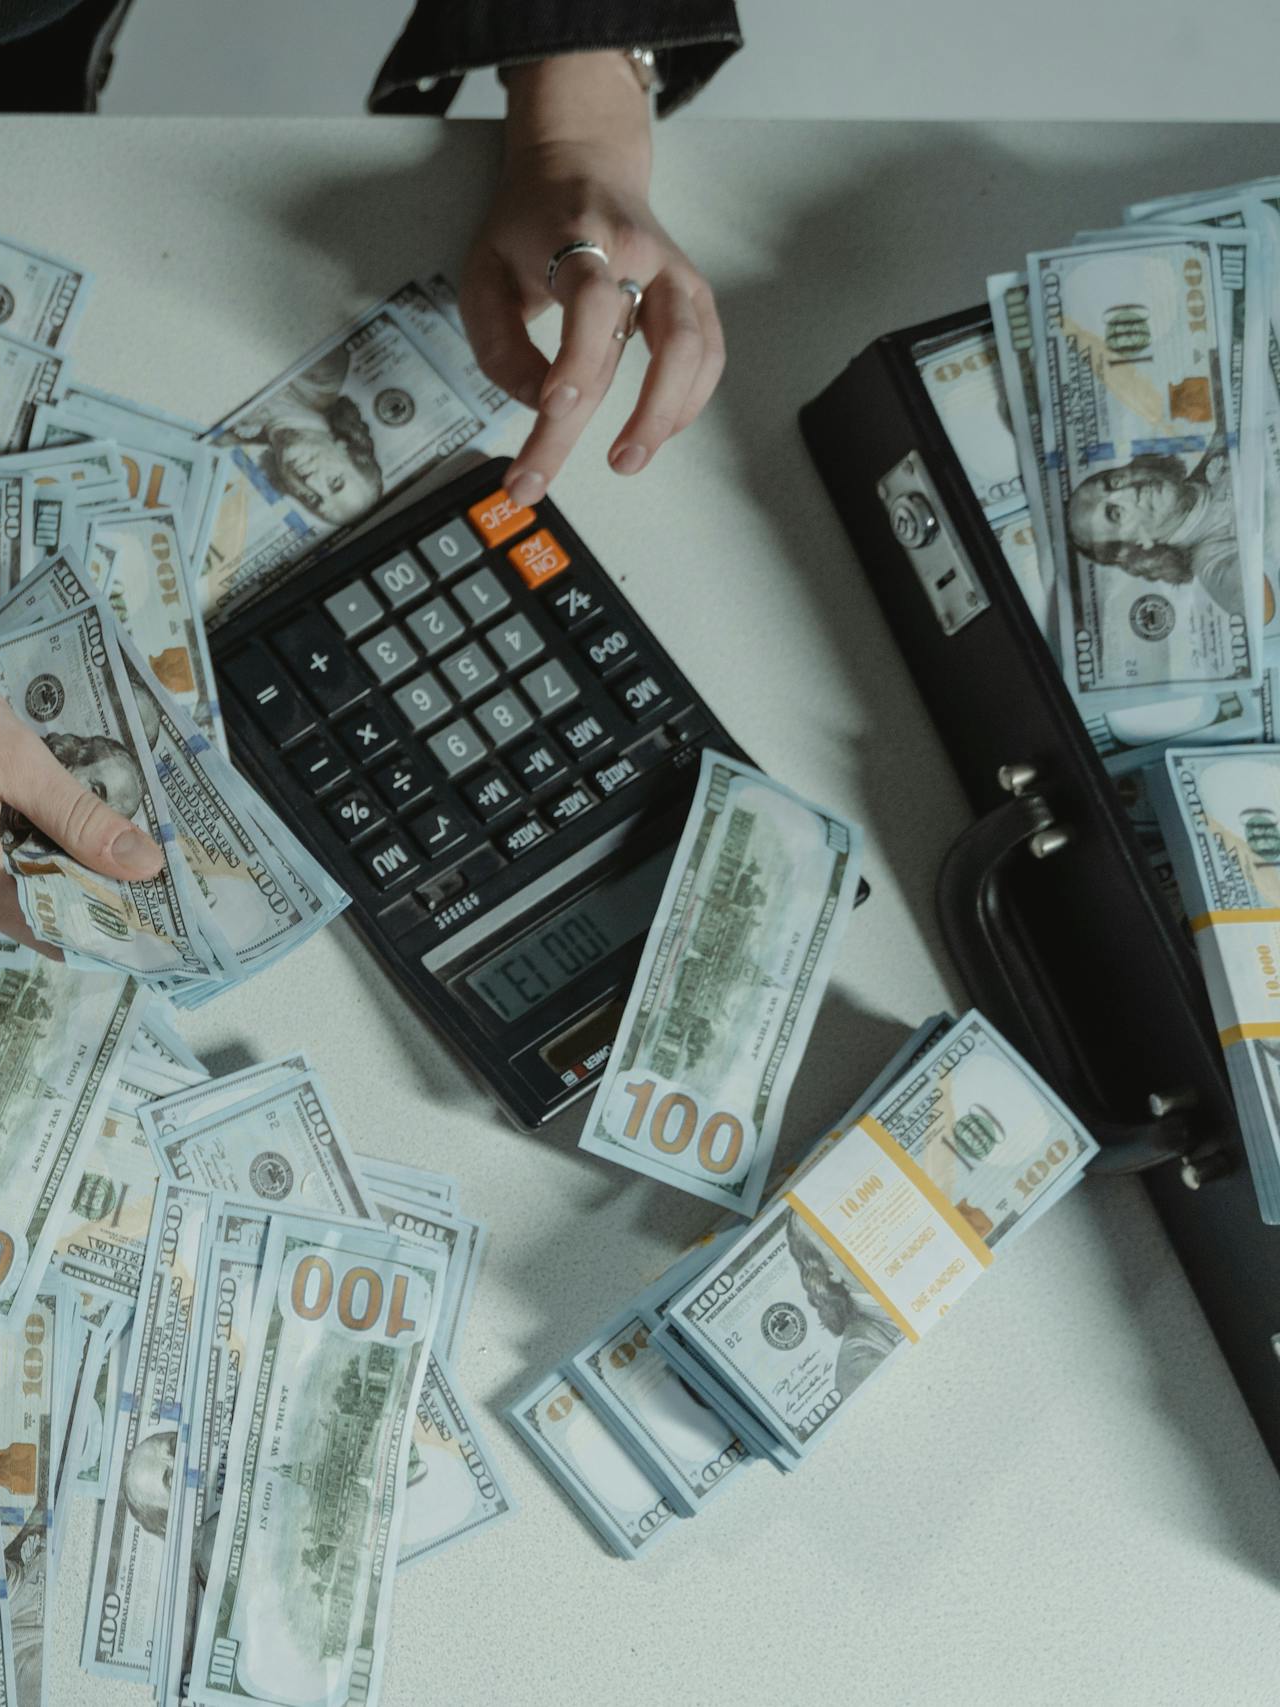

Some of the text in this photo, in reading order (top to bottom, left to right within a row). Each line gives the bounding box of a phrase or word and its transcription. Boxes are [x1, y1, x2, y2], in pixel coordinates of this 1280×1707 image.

[1182, 256, 1207, 333] 100
[3, 481, 20, 539] 100
[149, 531, 182, 610] 100
[435, 530, 461, 560] 0
[516, 534, 545, 560] AC
[529, 551, 559, 578] ON
[379, 558, 418, 595] 00
[469, 581, 489, 605] 1
[45, 633, 65, 654] B2
[75, 610, 114, 669] 100
[420, 608, 445, 637] 2
[500, 626, 525, 654] 4
[70, 622, 114, 737] FEDERAL RESERVE NOTE
[373, 638, 400, 667] 3
[455, 655, 480, 682] 5
[1072, 627, 1096, 686] 100
[1123, 657, 1138, 678] B2
[407, 684, 433, 713] 6
[489, 701, 515, 730] 8
[536, 673, 560, 700] 7
[621, 674, 662, 711] MC
[442, 731, 469, 760] 9
[563, 714, 603, 750] MR
[156, 746, 202, 809] UNITED
[193, 803, 243, 870] STATES
[471, 776, 509, 811] M+
[245, 858, 292, 918] 100
[368, 841, 410, 879] MU
[749, 931, 801, 1062] IN GOD WE TRUST
[927, 1031, 981, 1082] 100
[27, 1043, 89, 1174] IN GOD WE TRUST
[262, 1109, 282, 1132] B2
[296, 1086, 337, 1148] 100
[606, 1071, 754, 1181] 100
[933, 1096, 1013, 1177] 100
[290, 1099, 348, 1216] FEDERAL RESERVE NOTE
[1014, 1139, 1070, 1200] 100
[157, 1201, 186, 1268] 100
[389, 1210, 451, 1243] 100
[211, 1275, 239, 1342] 100
[289, 1254, 418, 1339] 100
[684, 1269, 740, 1322] 100
[702, 1239, 790, 1324] FEDERAL RESERVE NOTE
[908, 1255, 968, 1314] ONE HUNDRED
[19, 1312, 47, 1399] 100
[145, 1273, 183, 1428] UNITED STATES
[723, 1329, 744, 1350] B2
[790, 1387, 844, 1435] 100
[227, 1346, 276, 1578] THE UNITED STATES OF AMERICA
[257, 1383, 291, 1532] IN GOD WE TRUST
[455, 1437, 500, 1502] 100
[113, 1523, 141, 1653] FEDERAL RESERVE NOTE
[92, 1590, 124, 1660] 100
[207, 1634, 240, 1688] 100
